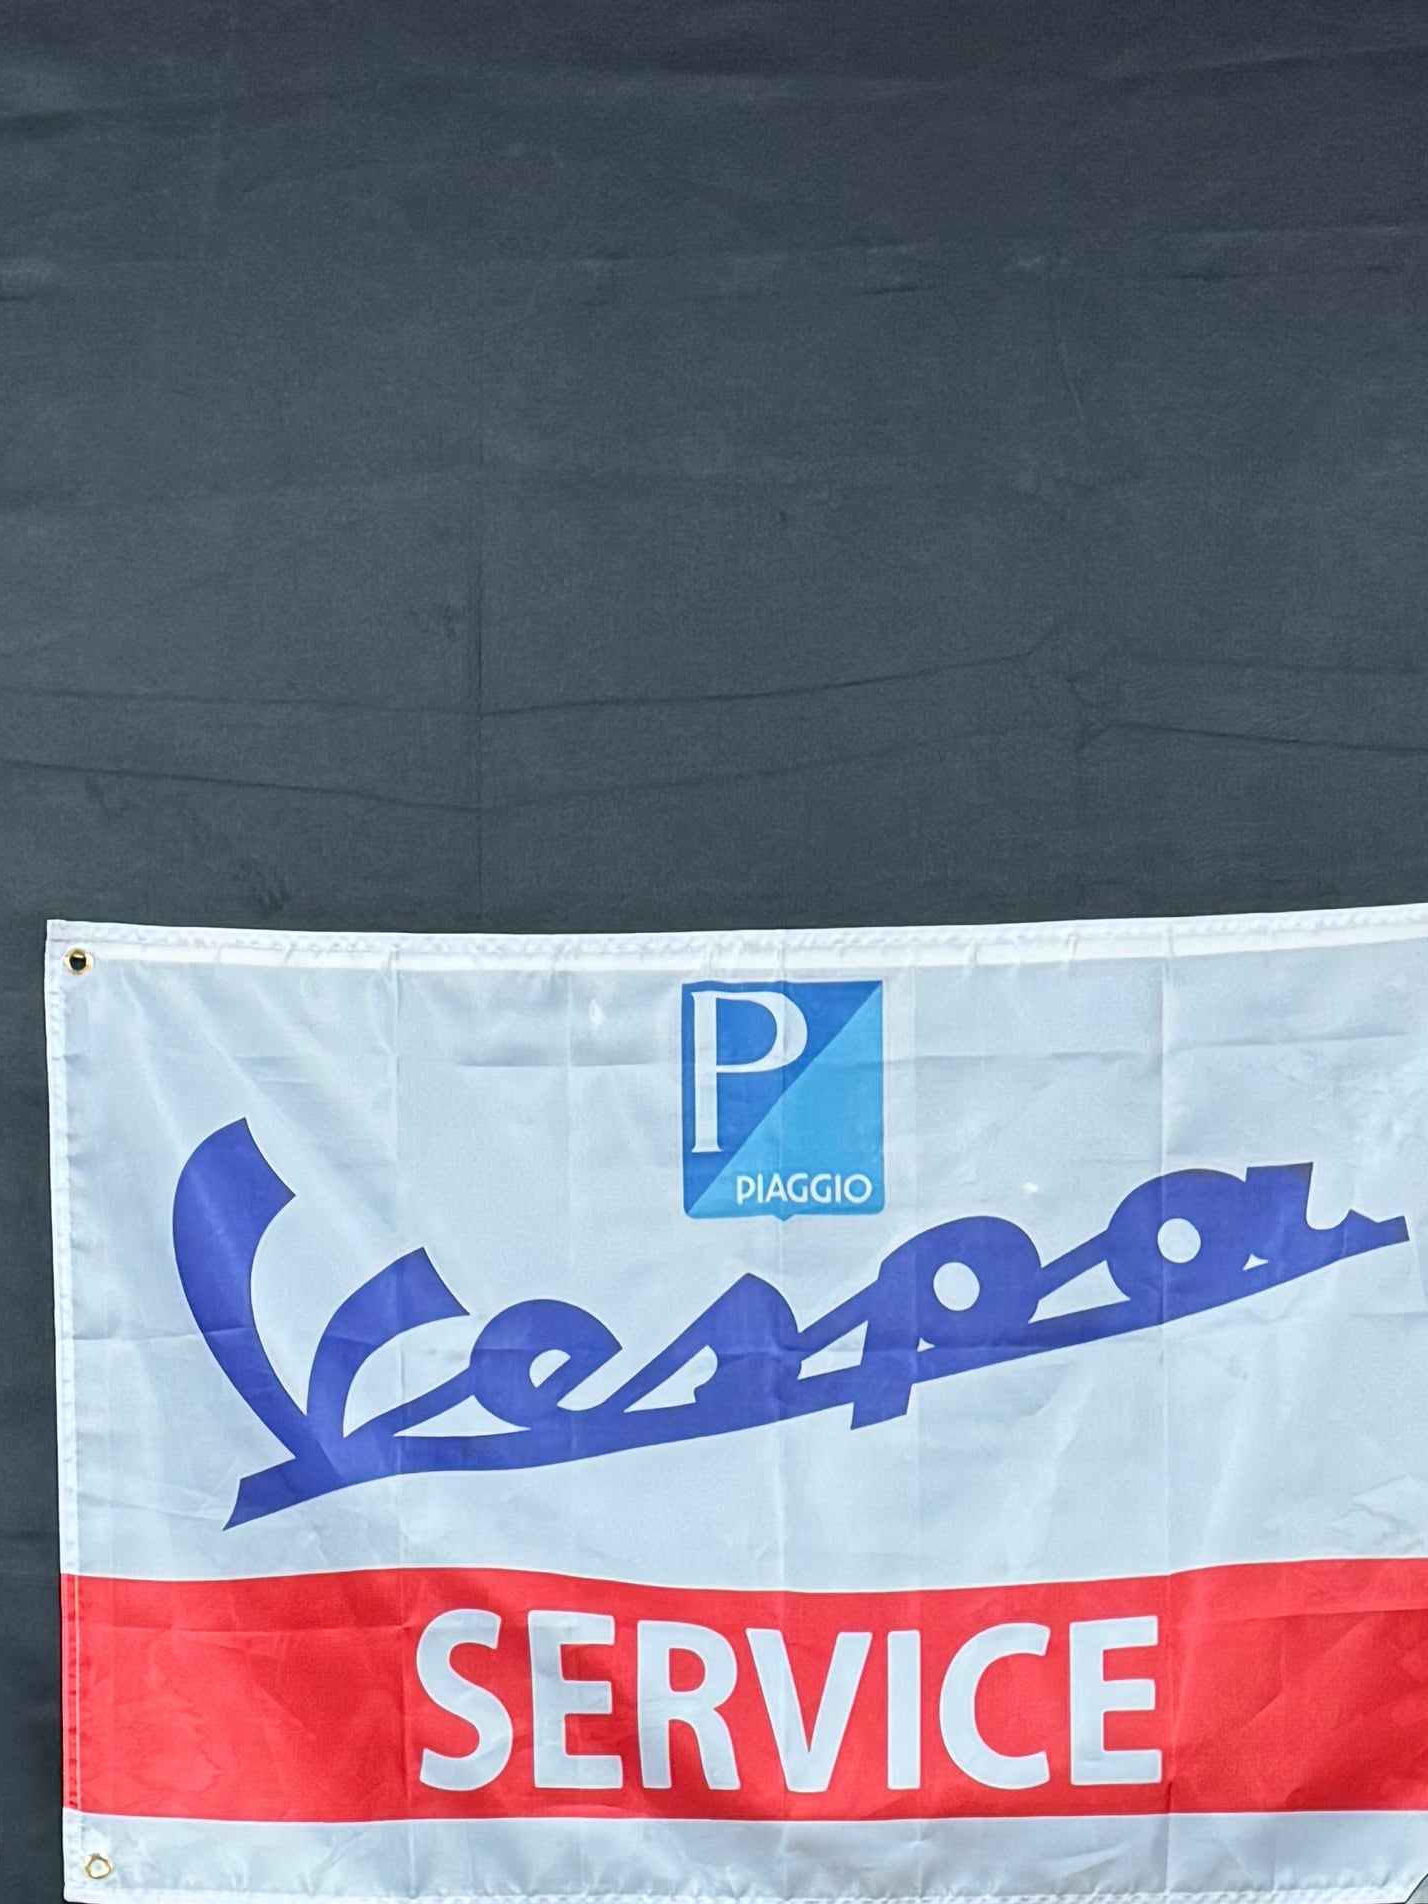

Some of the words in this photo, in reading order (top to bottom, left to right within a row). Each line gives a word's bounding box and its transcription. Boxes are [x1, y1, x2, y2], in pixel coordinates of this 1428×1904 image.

[691, 990, 808, 1153] P
[736, 1173, 872, 1205] PIAGGIO
[171, 1117, 1411, 1531] Vespa
[416, 1608, 1164, 1794] SERVICE
